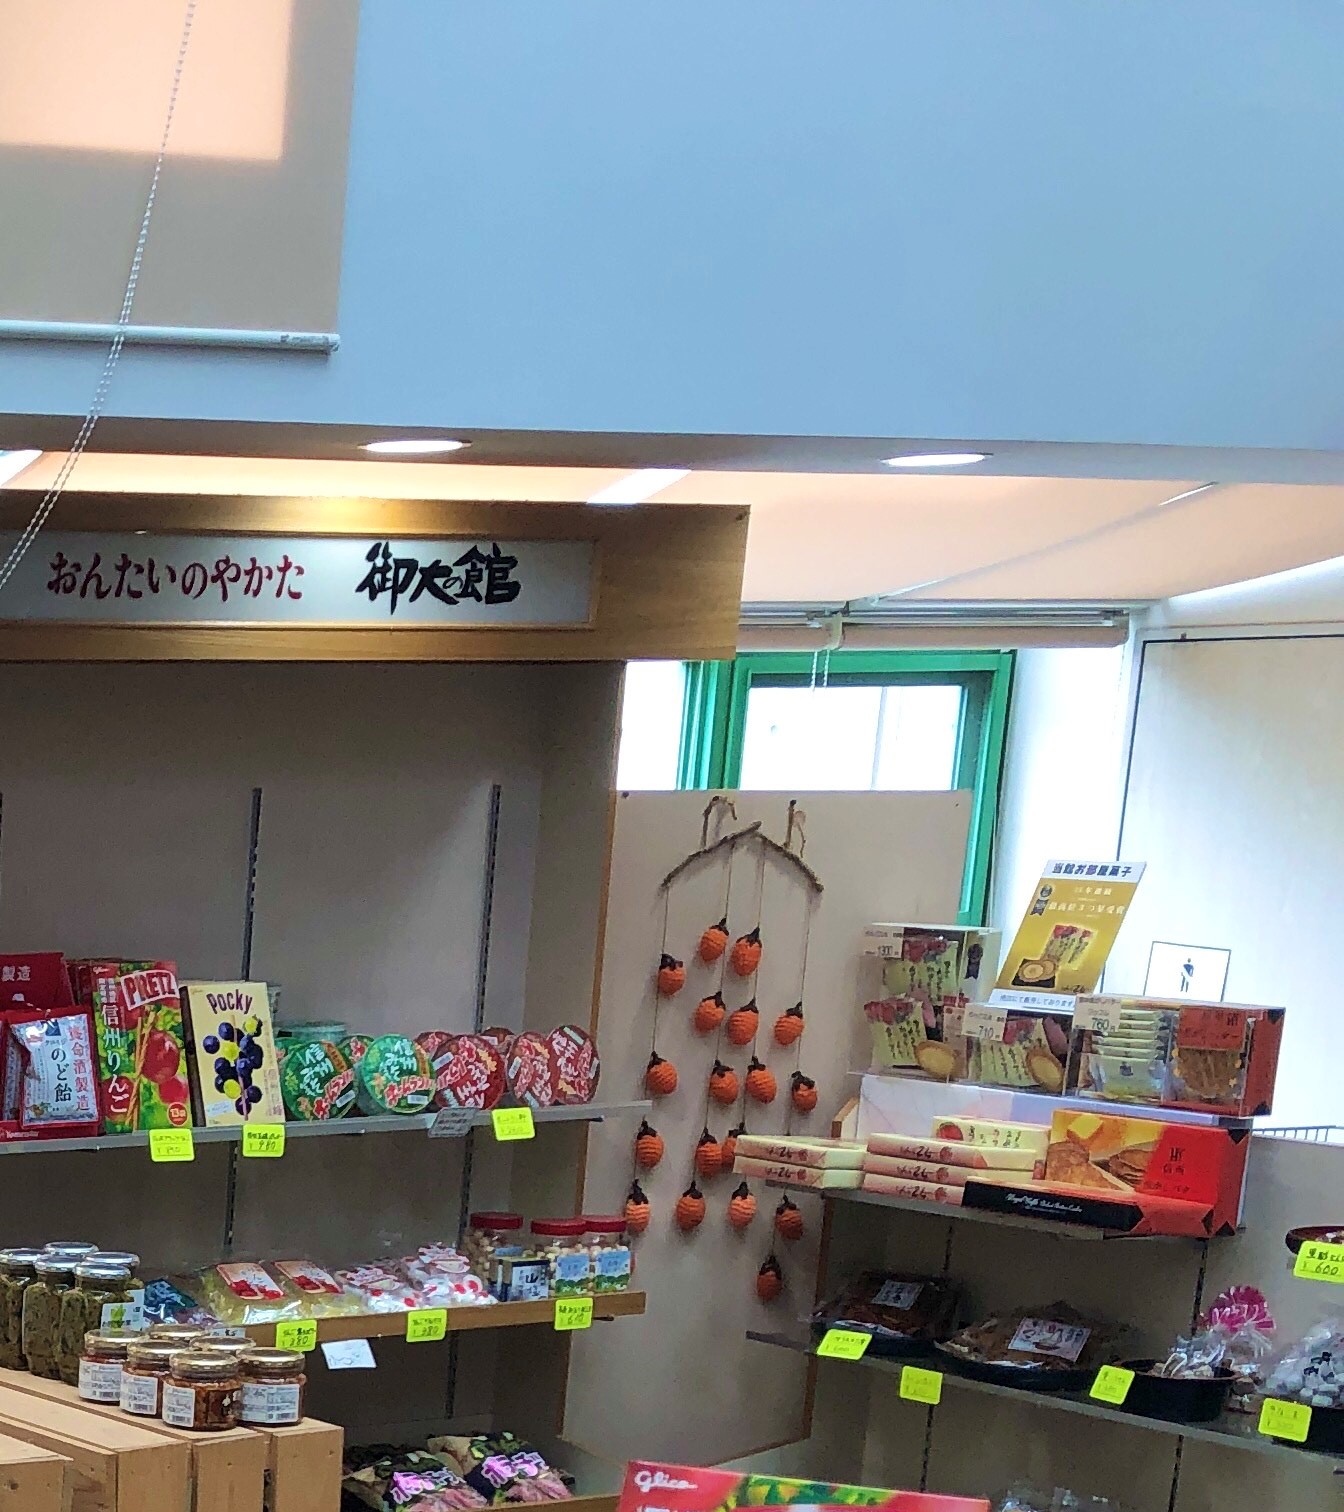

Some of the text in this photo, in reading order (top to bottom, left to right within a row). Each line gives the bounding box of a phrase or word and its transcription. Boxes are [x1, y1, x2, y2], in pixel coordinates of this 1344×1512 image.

[46, 551, 305, 602] おんたいのやかた
[123, 972, 176, 1006] PRETZ
[50, 1046, 73, 1104] のど飴
[68, 1023, 92, 1113] 養命酒製造
[101, 1004, 130, 1113] 信州りんご
[633, 1471, 699, 1493] Glico
